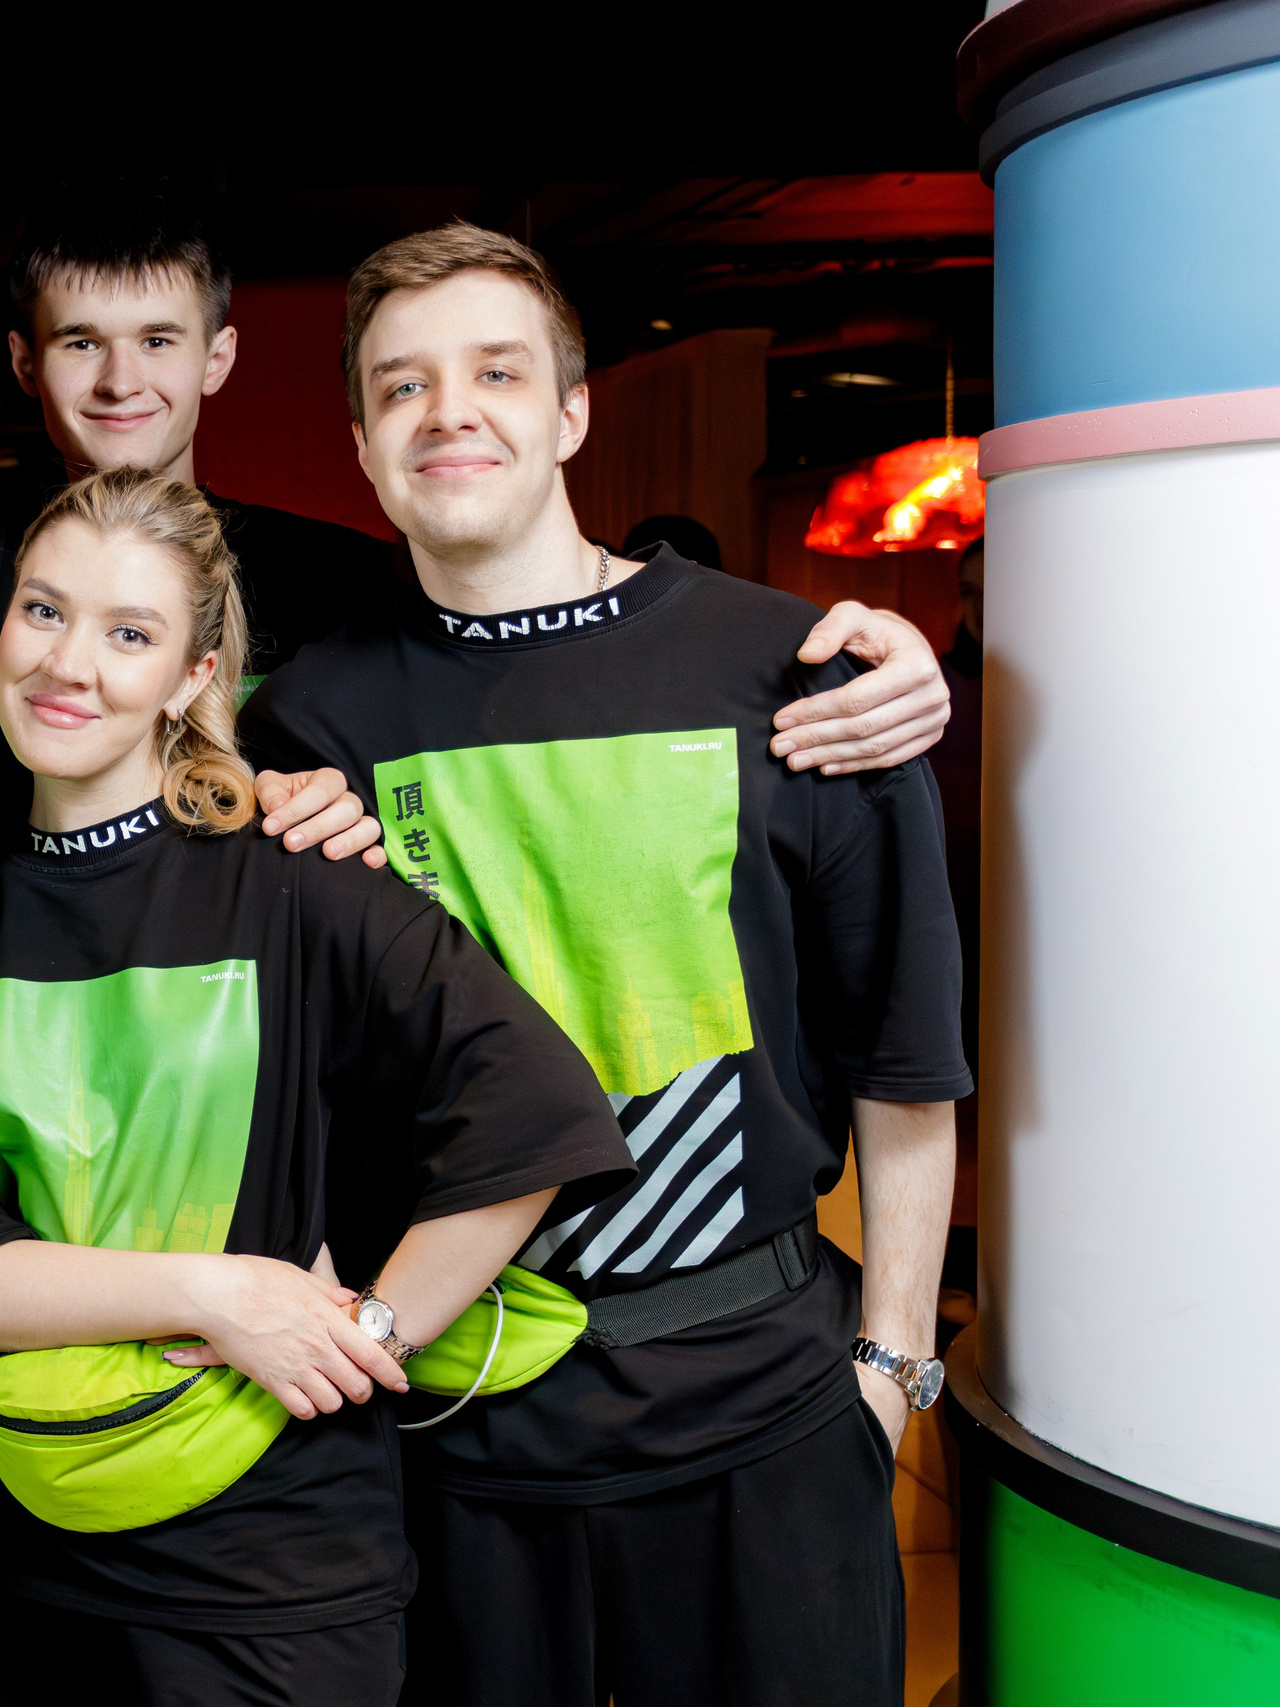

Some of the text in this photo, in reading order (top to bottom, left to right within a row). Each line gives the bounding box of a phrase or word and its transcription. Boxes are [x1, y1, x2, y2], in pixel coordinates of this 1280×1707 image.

[439, 597, 620, 640] TANUKI
[668, 741, 722, 752] TANUKI.RU
[31, 809, 160, 855] TANUKI
[200, 971, 245, 983] TANUKI.RU
